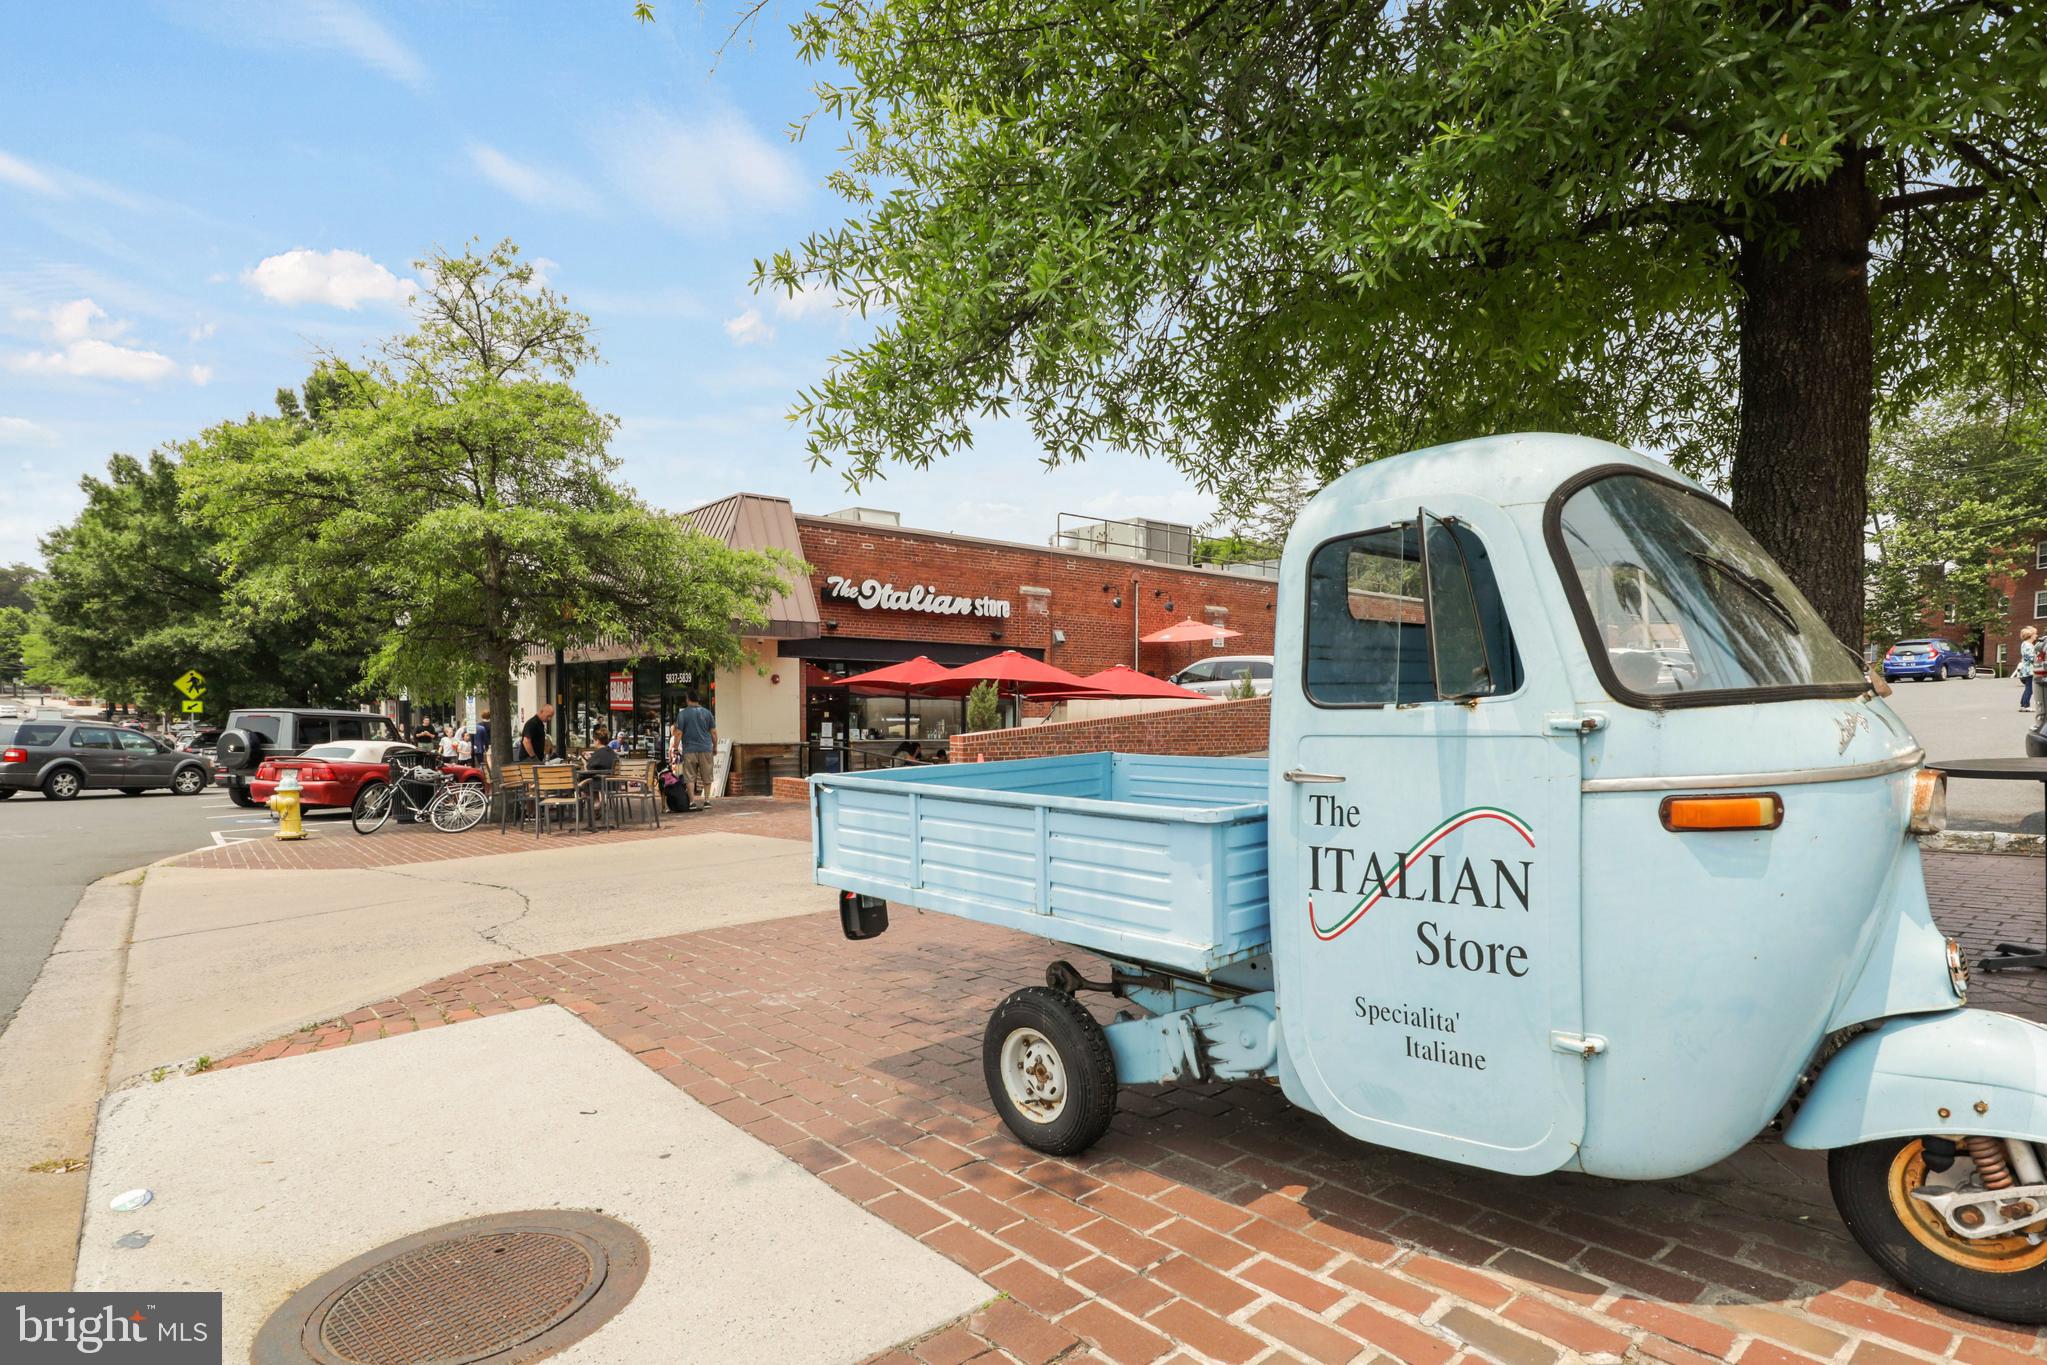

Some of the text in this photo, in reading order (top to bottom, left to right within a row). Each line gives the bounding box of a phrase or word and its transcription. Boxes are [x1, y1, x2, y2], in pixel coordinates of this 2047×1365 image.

[827, 576, 1010, 618] The Italian store
[665, 673, 692, 684] 5837-5839
[1309, 794, 1361, 828] The
[1309, 845, 1534, 913] ITALIAN
[1416, 921, 1529, 977] Store
[1355, 996, 1460, 1033] Specialita'
[1405, 1036, 1487, 1070] Italiane
